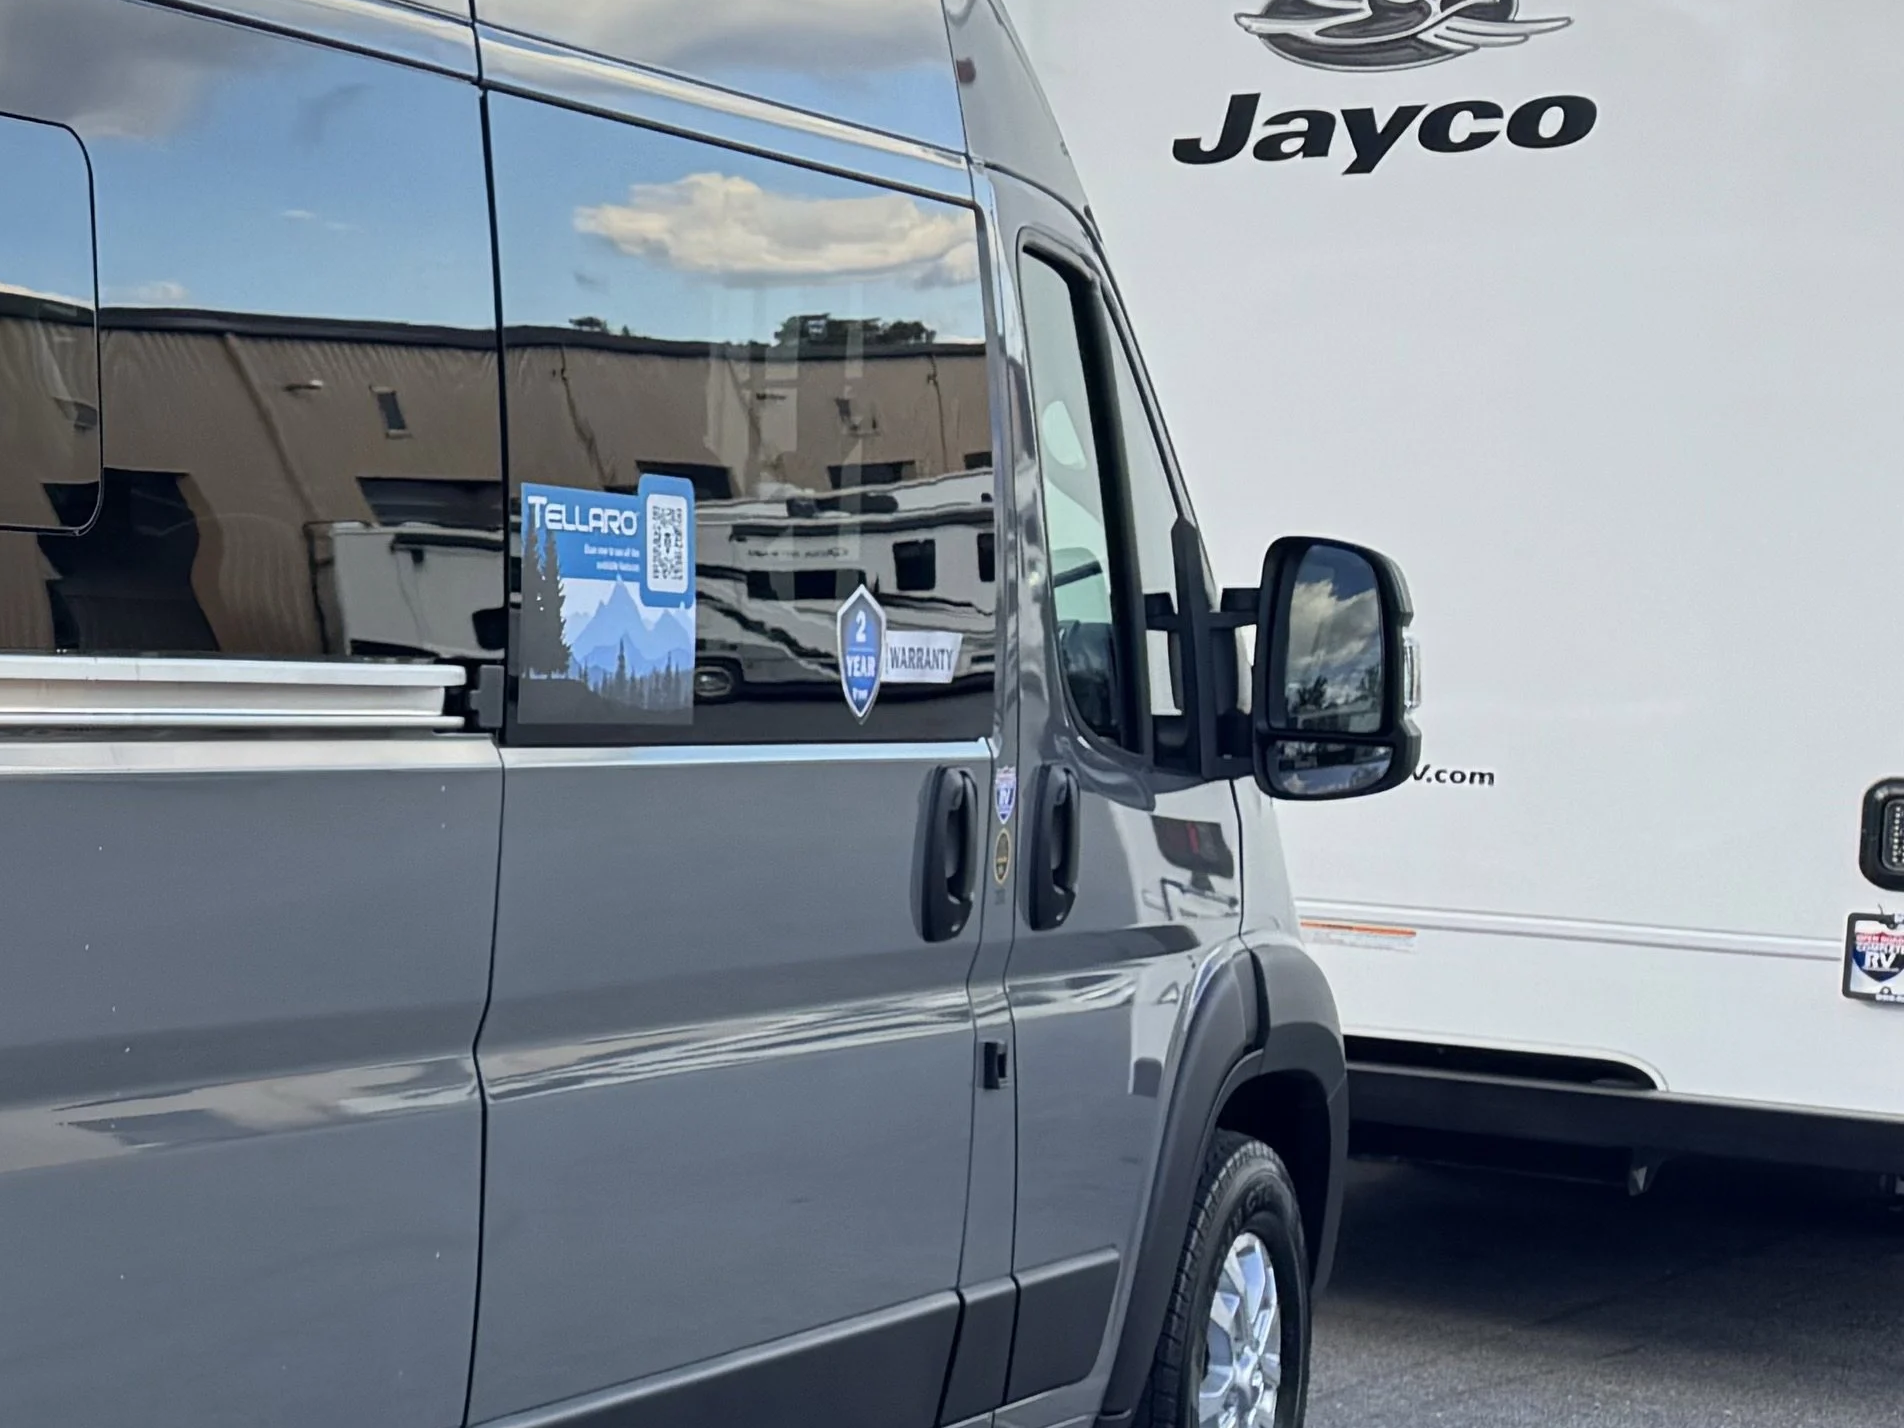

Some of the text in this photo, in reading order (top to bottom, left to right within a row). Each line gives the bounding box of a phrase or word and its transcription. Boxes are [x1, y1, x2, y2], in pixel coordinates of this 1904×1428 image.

[1172, 92, 1597, 175] Jayco
[527, 495, 638, 537] TELLARO
[856, 610, 867, 643] 2
[847, 655, 876, 677] YEAR
[890, 647, 953, 670] WARRANTY
[1863, 952, 1897, 970] RV
